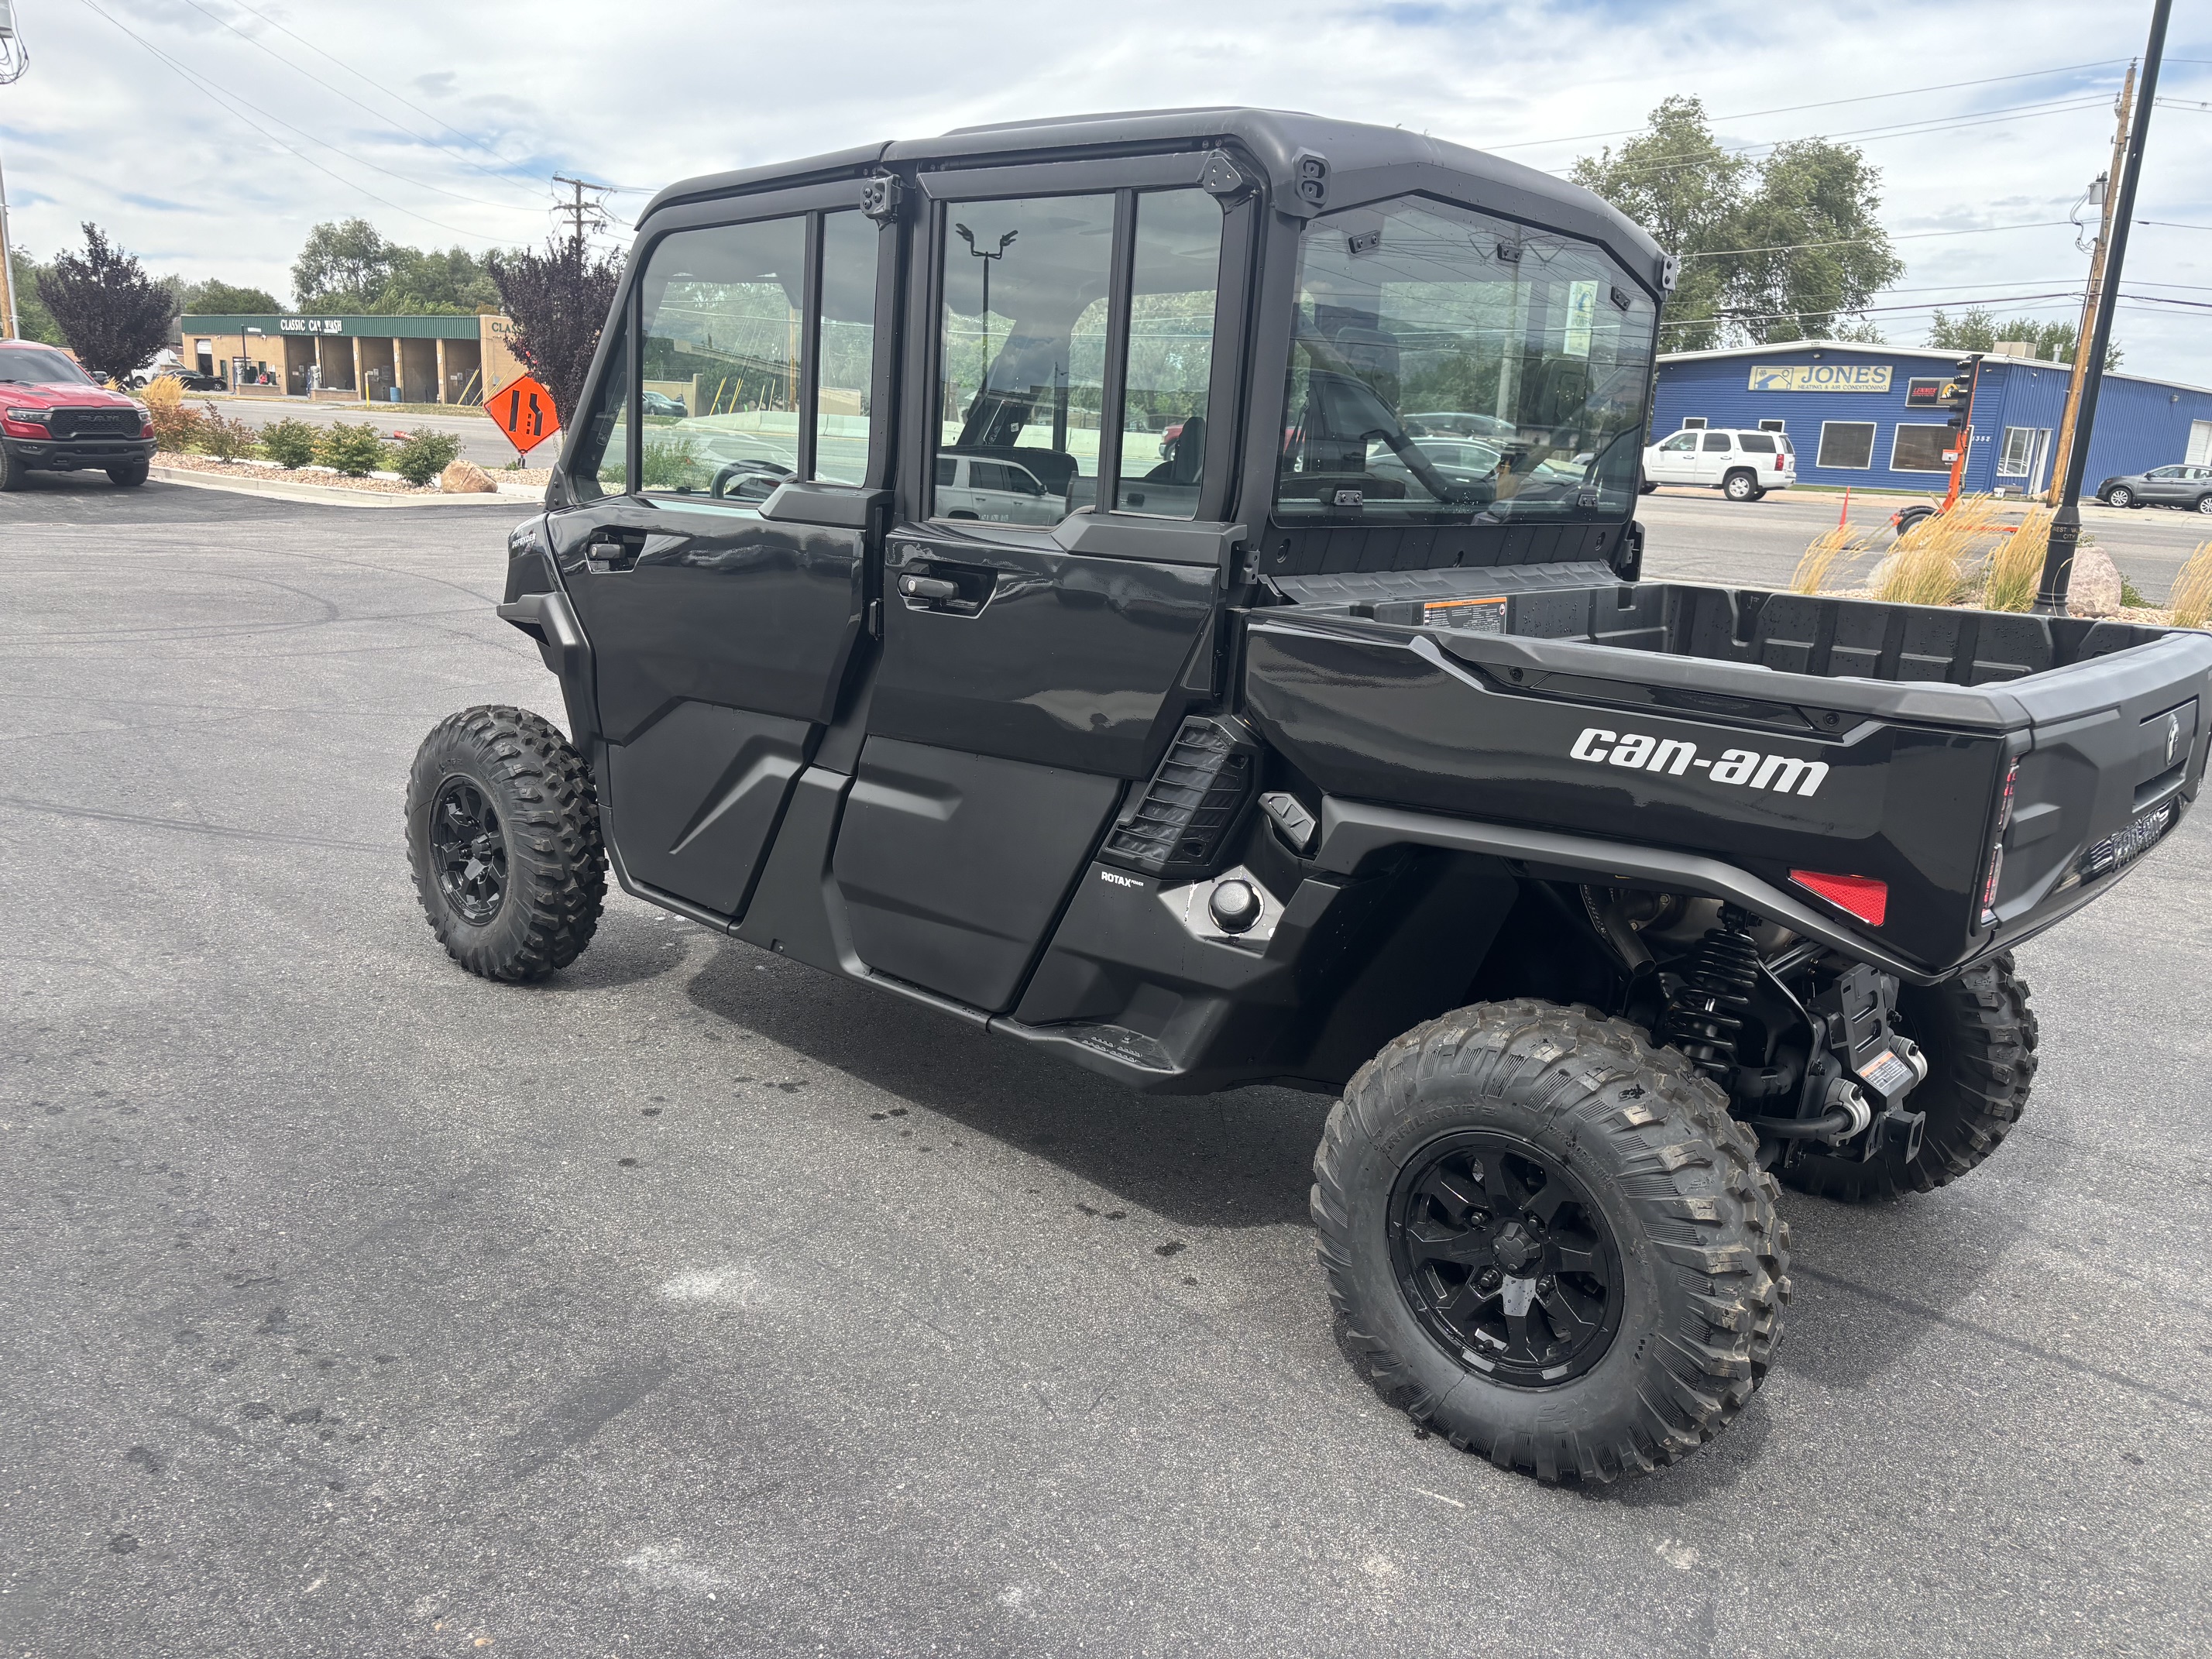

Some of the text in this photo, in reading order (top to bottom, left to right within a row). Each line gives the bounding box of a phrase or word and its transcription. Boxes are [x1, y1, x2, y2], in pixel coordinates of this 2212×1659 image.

[280, 319, 342, 331] CLASSIC CAR WASH
[491, 322, 523, 334] CLASS
[1801, 366, 1887, 383] JONES
[512, 532, 536, 548] DEFENDER
[1569, 728, 1829, 797] can-am
[1101, 871, 1131, 888] ROTAX
